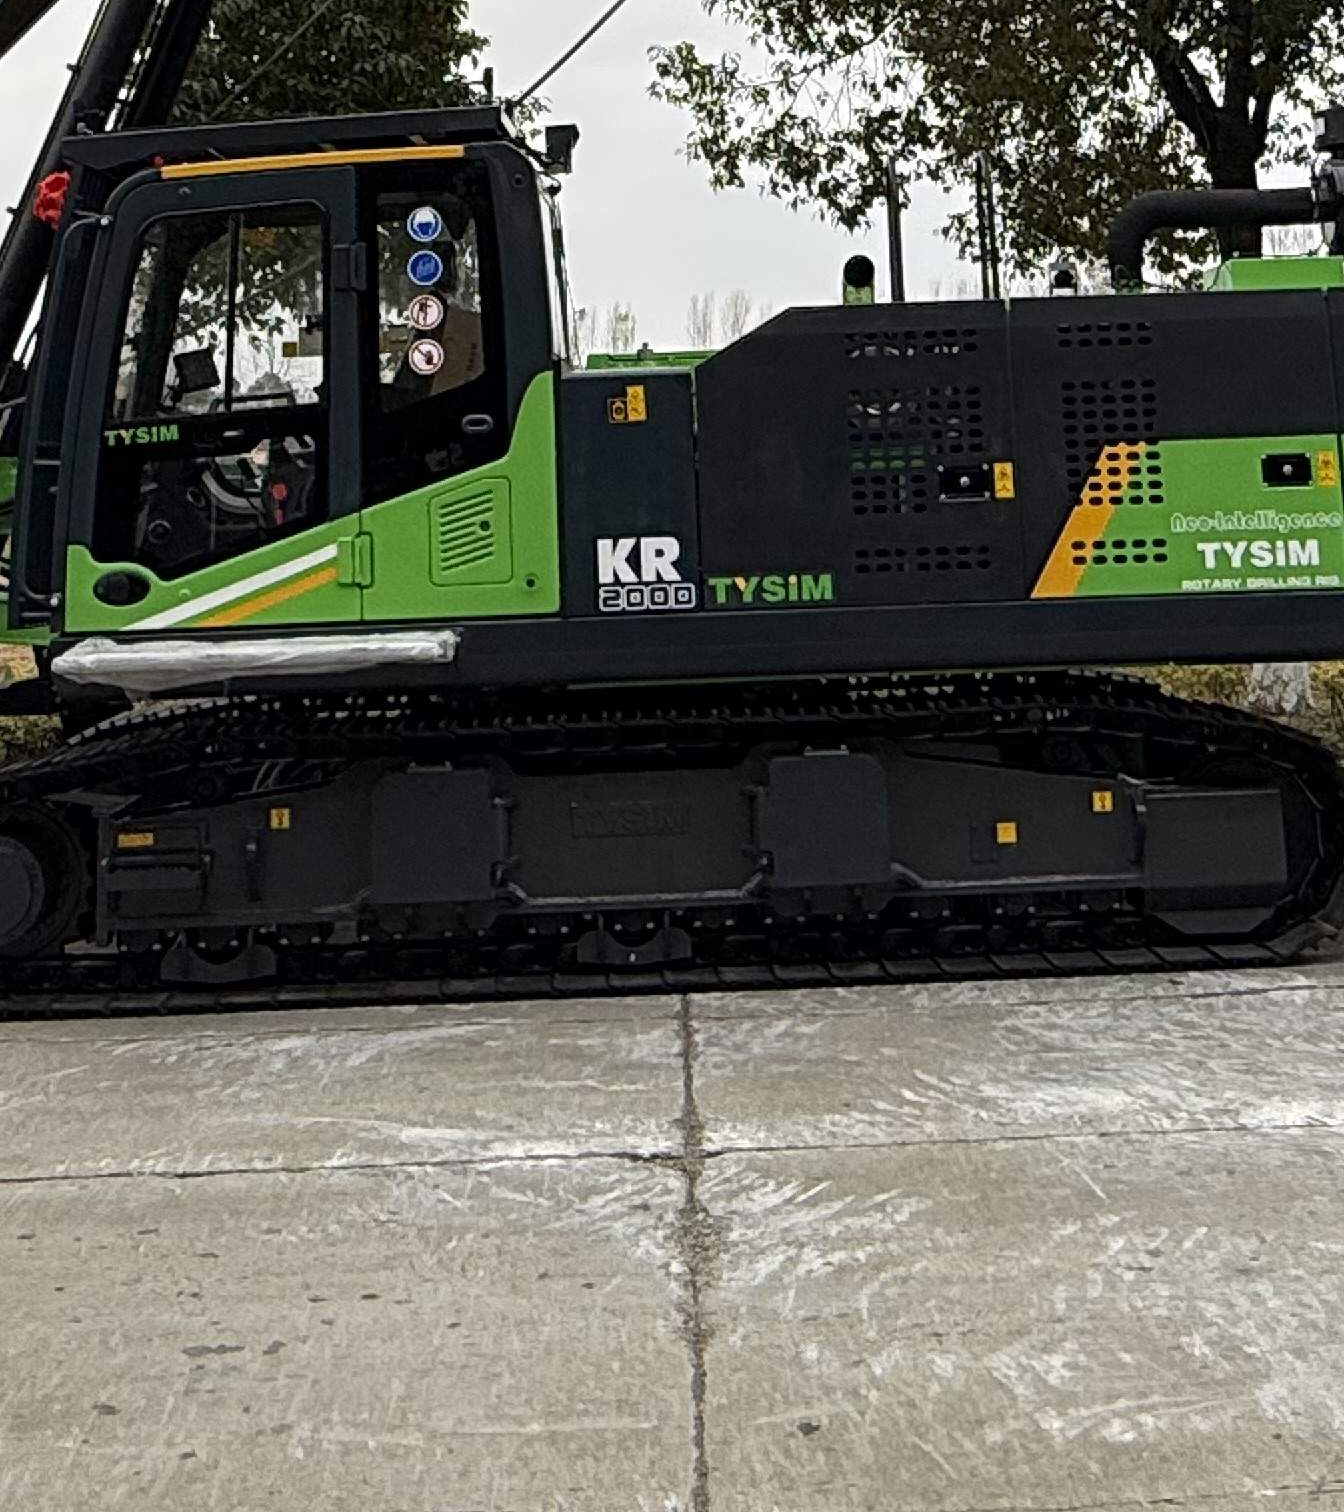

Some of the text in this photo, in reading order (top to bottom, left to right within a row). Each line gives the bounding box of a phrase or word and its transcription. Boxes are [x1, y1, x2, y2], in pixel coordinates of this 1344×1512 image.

[103, 424, 179, 447] TYSIM
[596, 536, 682, 584] KR
[1182, 577, 1242, 591] ROTARY
[1315, 574, 1340, 587] RIG
